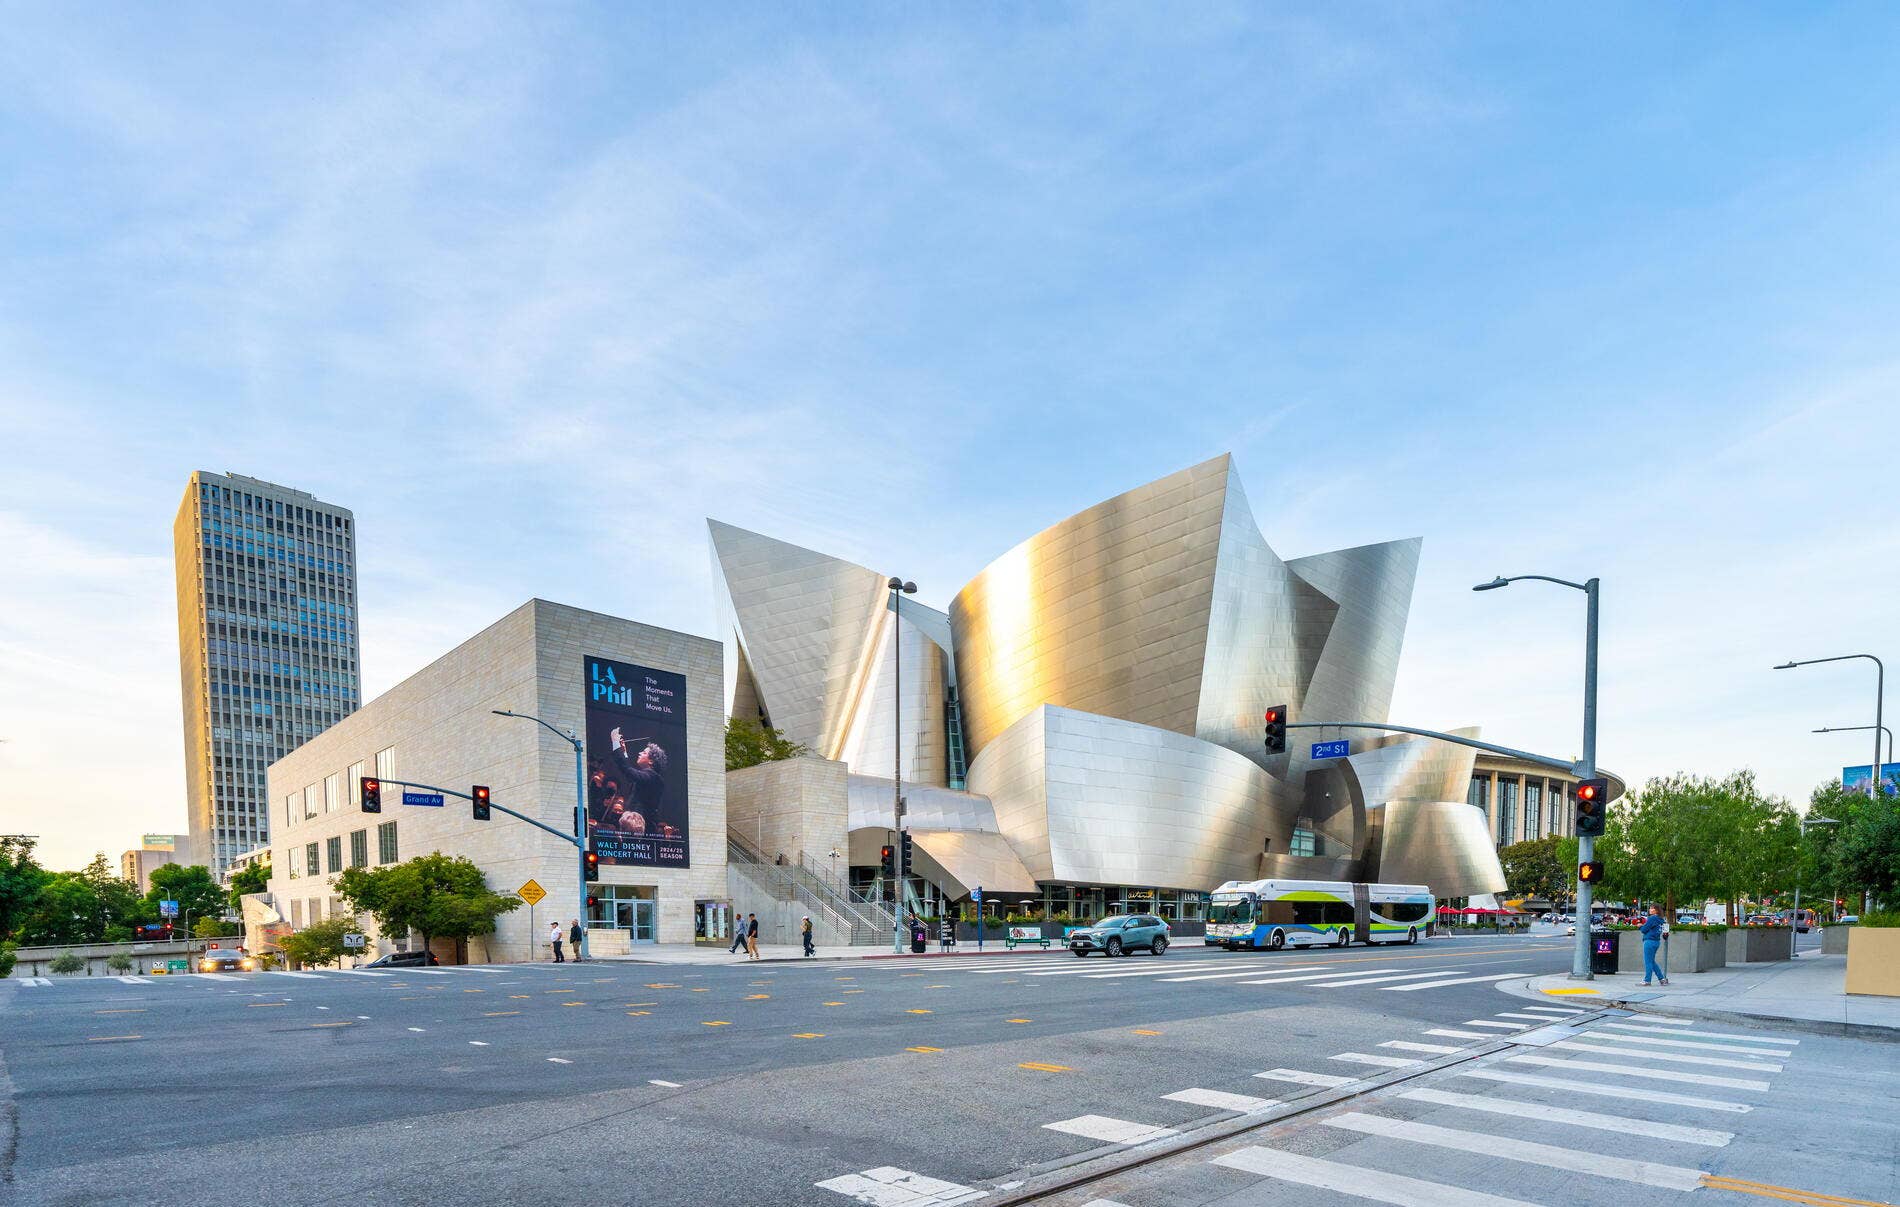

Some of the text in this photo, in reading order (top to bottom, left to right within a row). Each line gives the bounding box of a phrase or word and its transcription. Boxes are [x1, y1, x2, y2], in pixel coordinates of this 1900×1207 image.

[593, 663, 617, 684] LA
[645, 677, 657, 685] The
[593, 682, 632, 706] Phil
[645, 686, 673, 697] Moments
[646, 694, 660, 703] That
[646, 703, 673, 714] Move Us.
[1316, 744, 1344, 757] 2nd St
[406, 795, 428, 803] Grand
[622, 843, 650, 851] DISNEY
[597, 850, 631, 858] CONCERT
